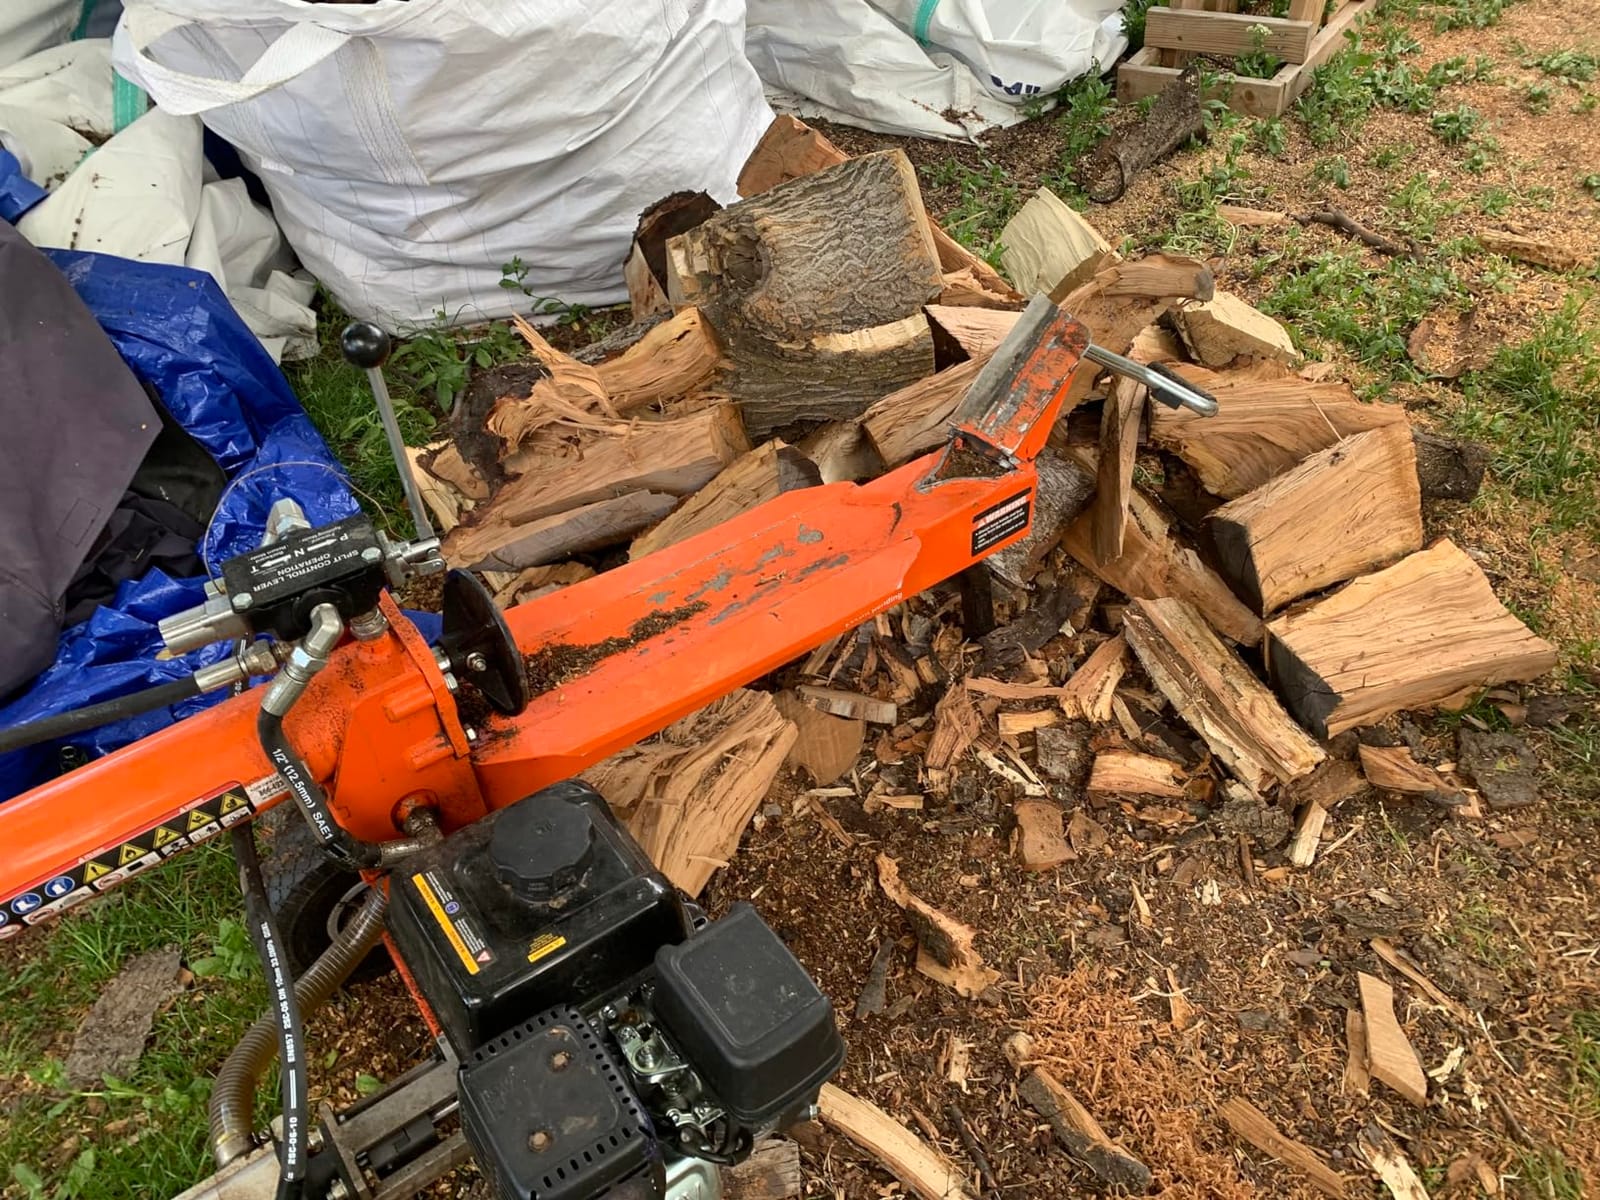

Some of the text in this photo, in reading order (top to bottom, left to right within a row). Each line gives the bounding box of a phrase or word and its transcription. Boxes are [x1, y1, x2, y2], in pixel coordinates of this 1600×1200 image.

[340, 533, 349, 541] P
[295, 548, 305, 557] N
[334, 550, 359, 563] SPLIT
[277, 553, 331, 576] OPERATION
[287, 560, 331, 579] CONTROL
[253, 577, 285, 592] LEVER
[272, 748, 289, 764] 1/2"
[283, 765, 316, 809] (12.5mm)
[313, 811, 334, 840] SAE1
